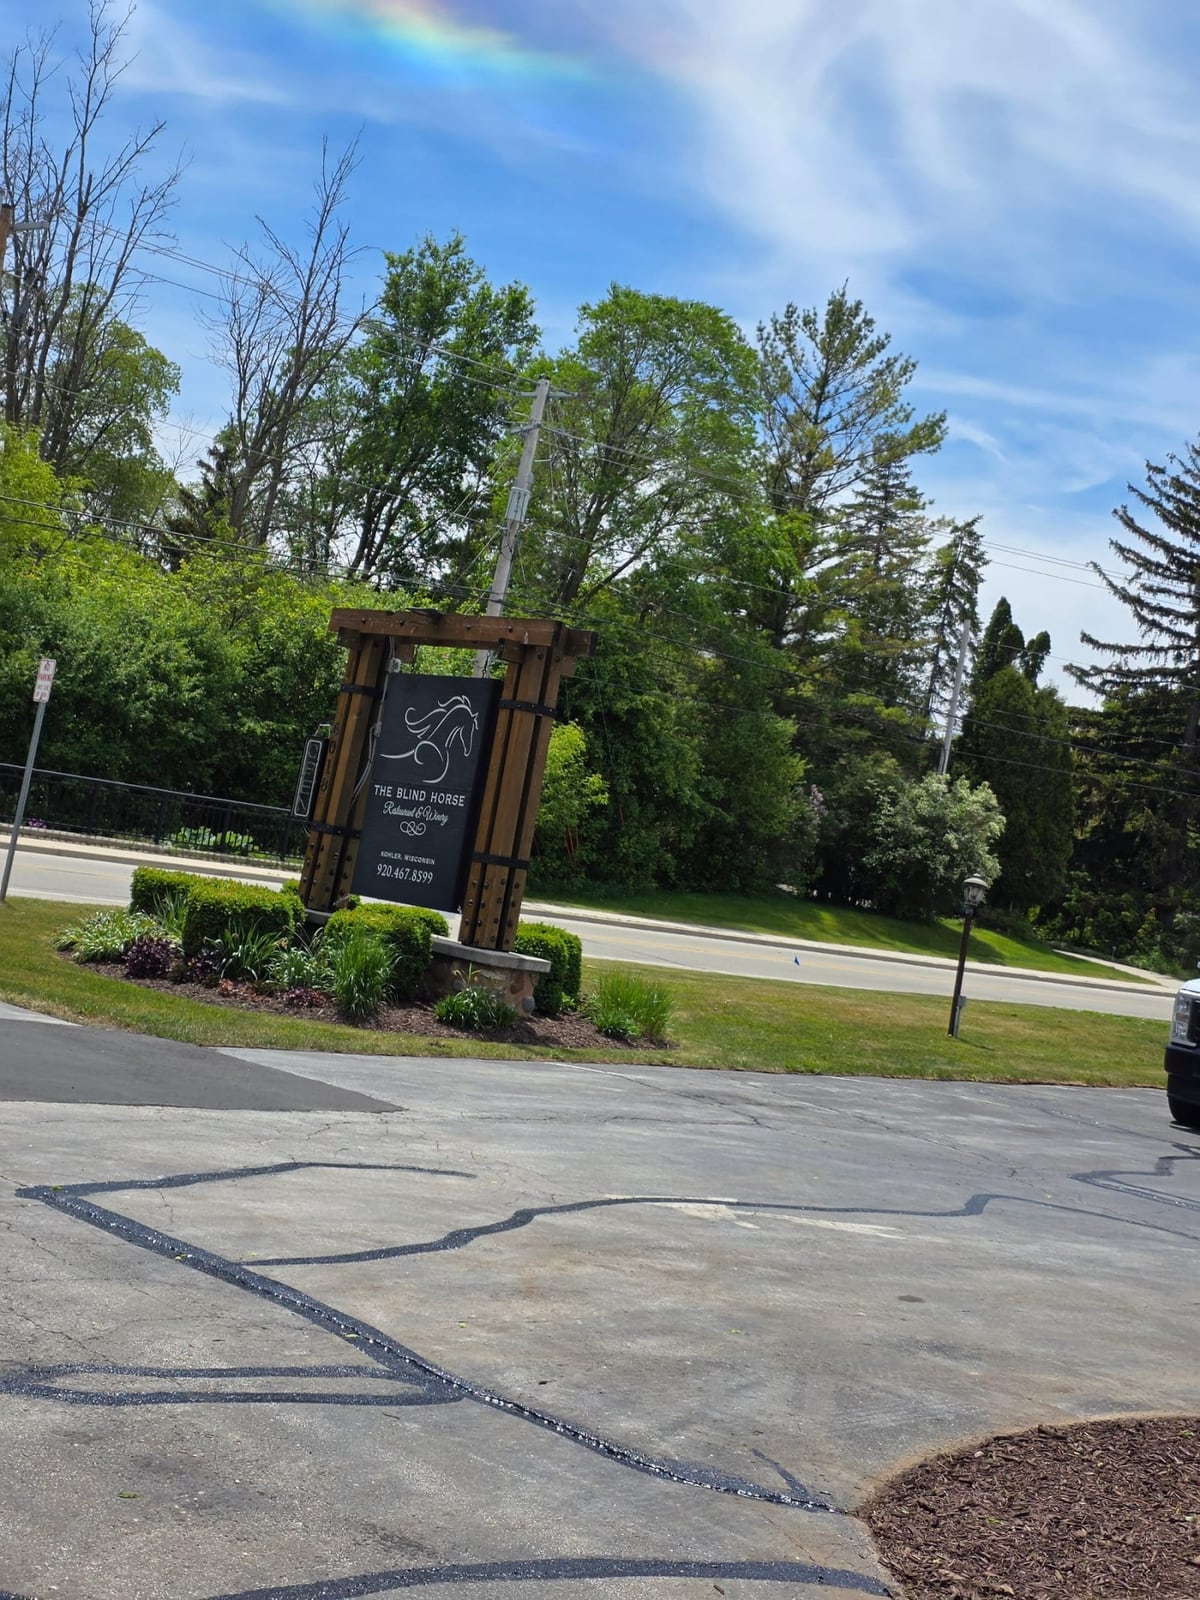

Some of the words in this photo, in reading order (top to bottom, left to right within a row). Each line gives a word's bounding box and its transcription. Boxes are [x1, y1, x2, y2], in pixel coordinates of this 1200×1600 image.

[374, 785, 393, 797] THE
[396, 787, 426, 801] BLIND
[430, 791, 466, 807] HORSE
[404, 854, 436, 865] WISCONSIN
[376, 863, 434, 885] 920.467.8599
